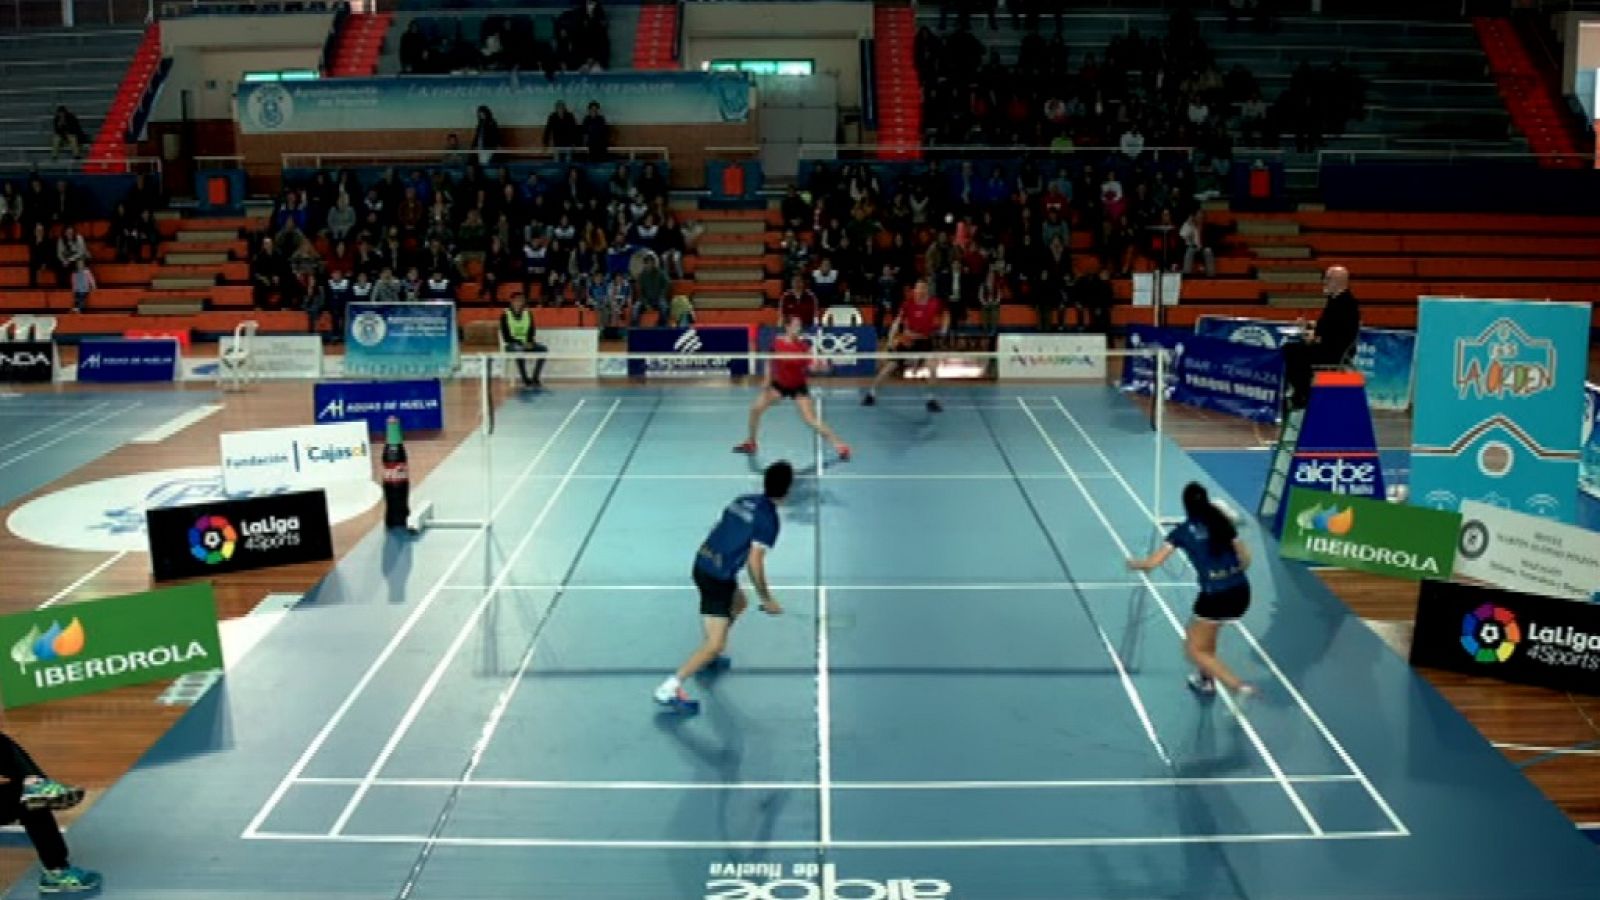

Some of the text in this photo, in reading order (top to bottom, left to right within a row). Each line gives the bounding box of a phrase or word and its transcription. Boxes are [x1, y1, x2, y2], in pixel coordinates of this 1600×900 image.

[240, 515, 301, 538] LaLiga
[1304, 535, 1440, 575] IBERDROLA
[34, 641, 209, 689] IBERDROLA
